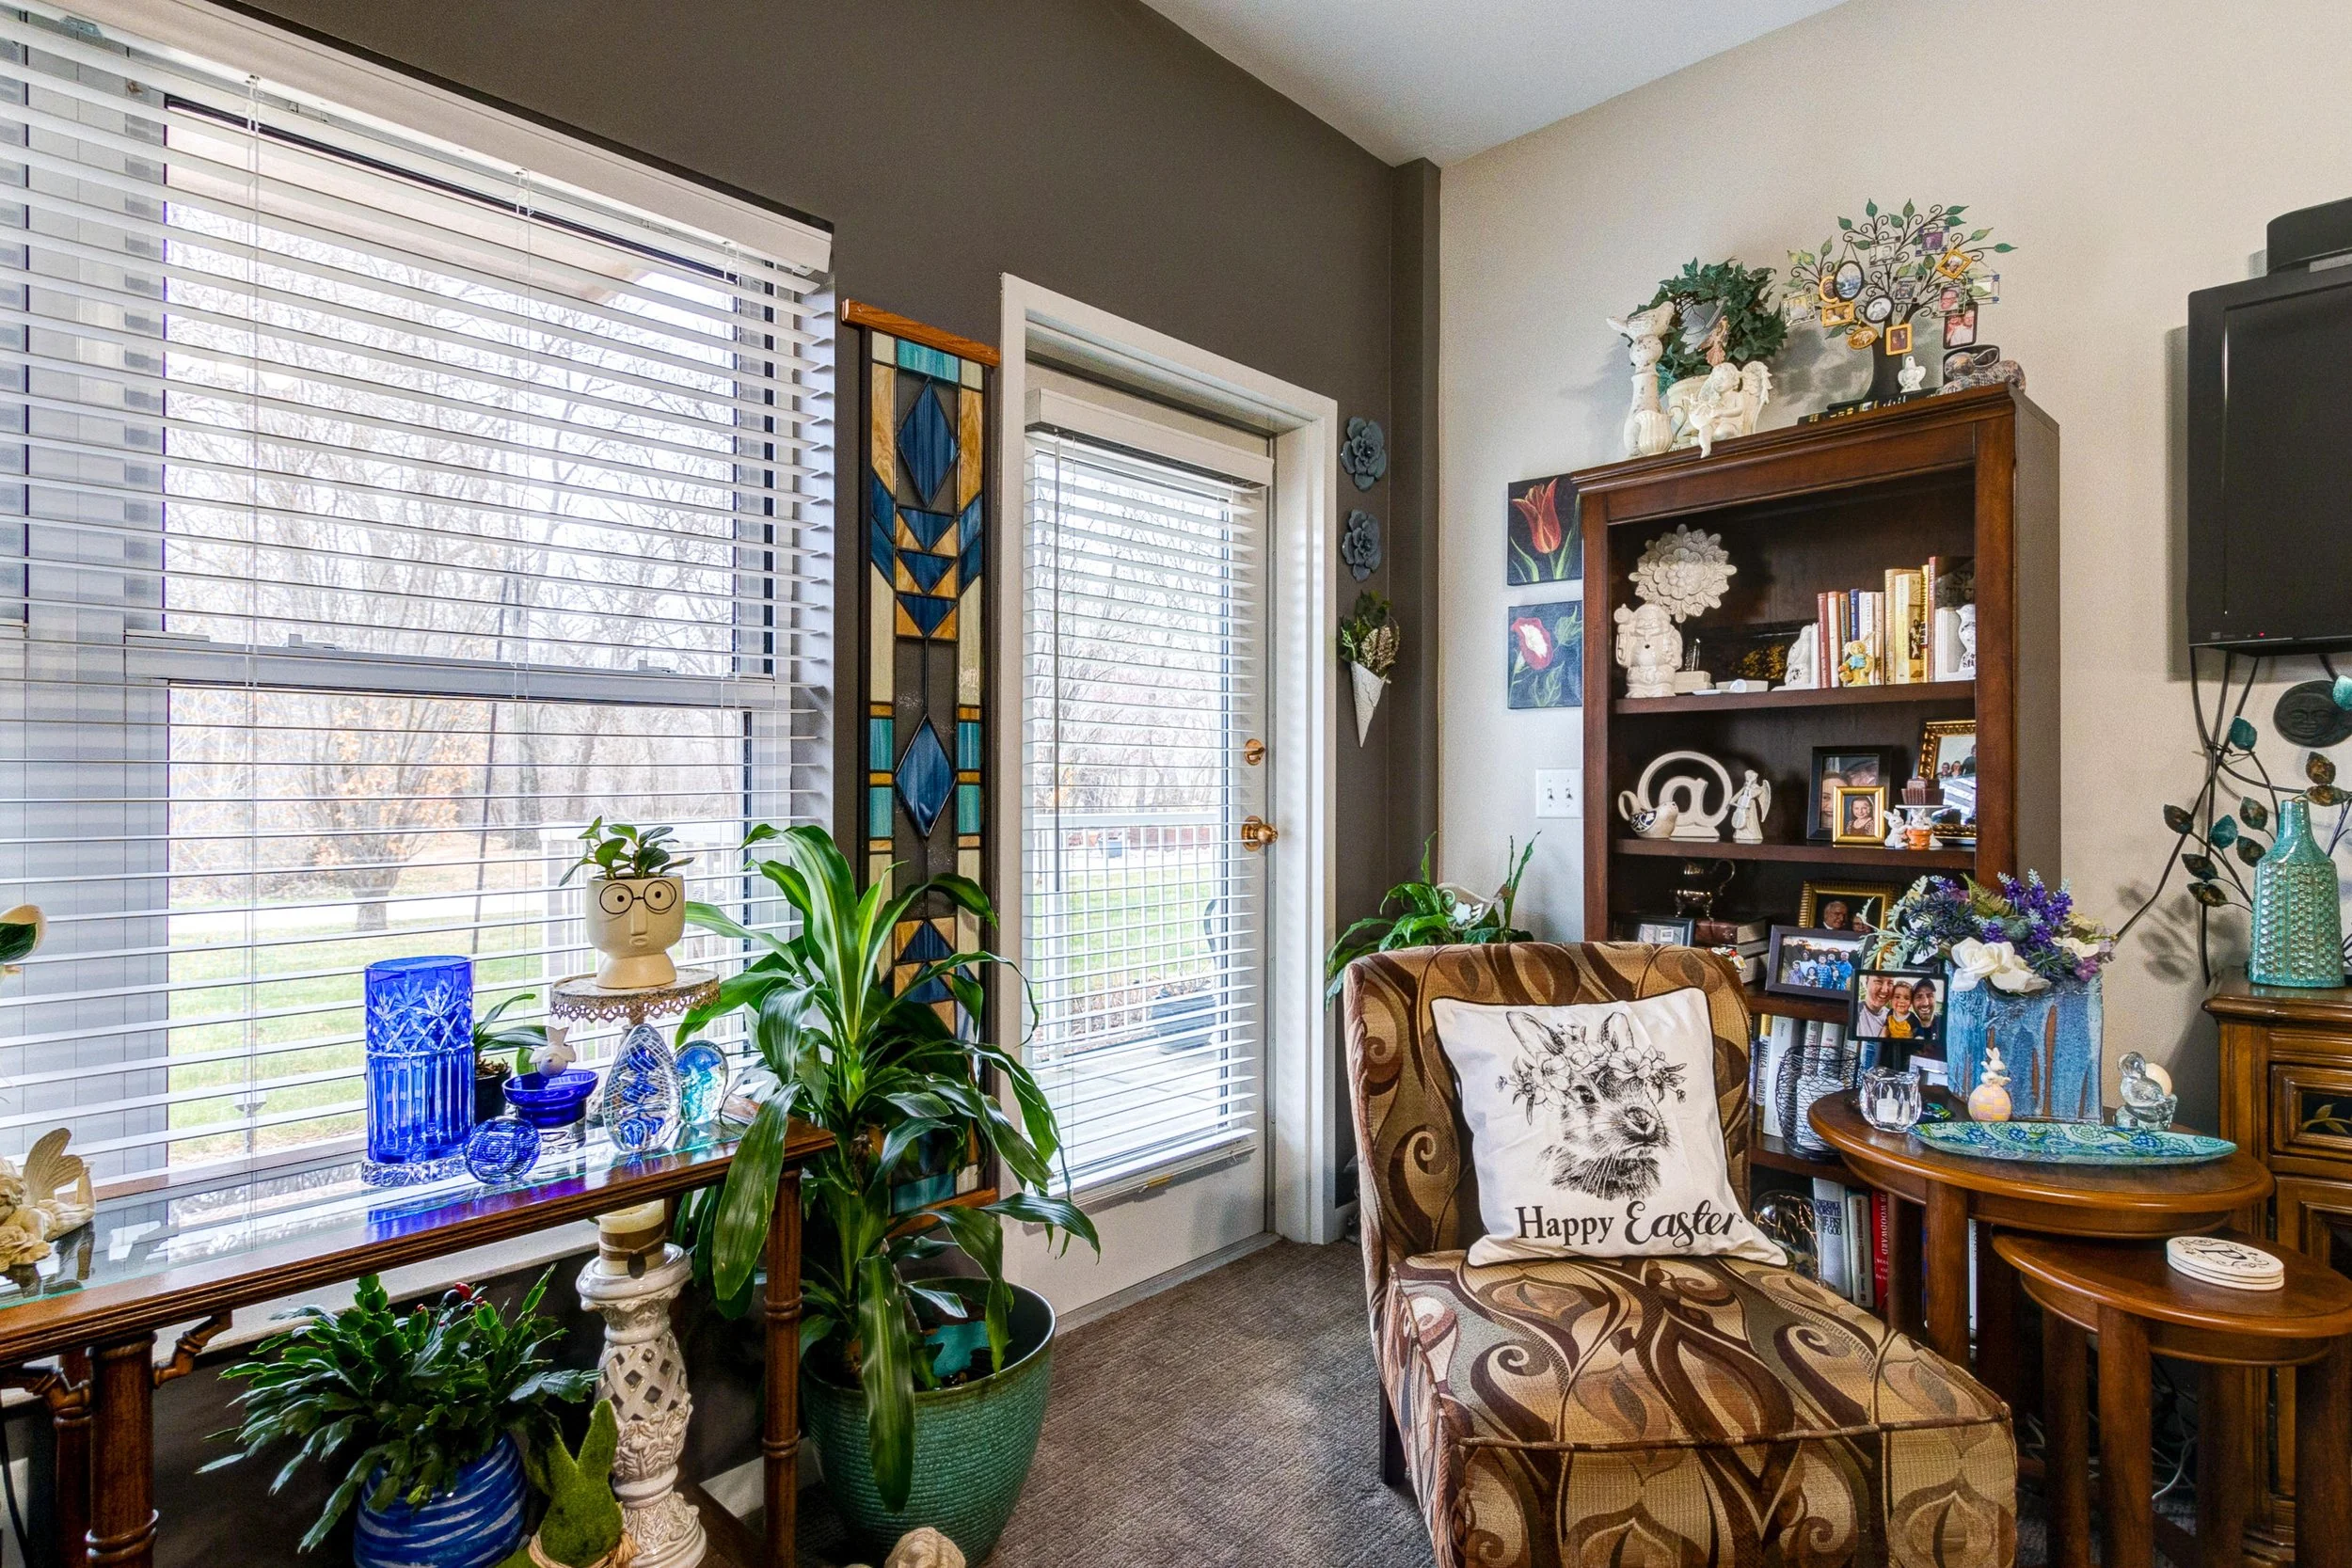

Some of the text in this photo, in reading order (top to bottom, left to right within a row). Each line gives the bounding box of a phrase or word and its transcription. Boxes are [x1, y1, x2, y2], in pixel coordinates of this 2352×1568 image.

[1759, 1038, 1769, 1069] AMERICA
[1757, 1078, 1766, 1102] WORLD
[1515, 1200, 1742, 1248] Happy Easter
[1827, 1226, 1842, 1236] GOD
